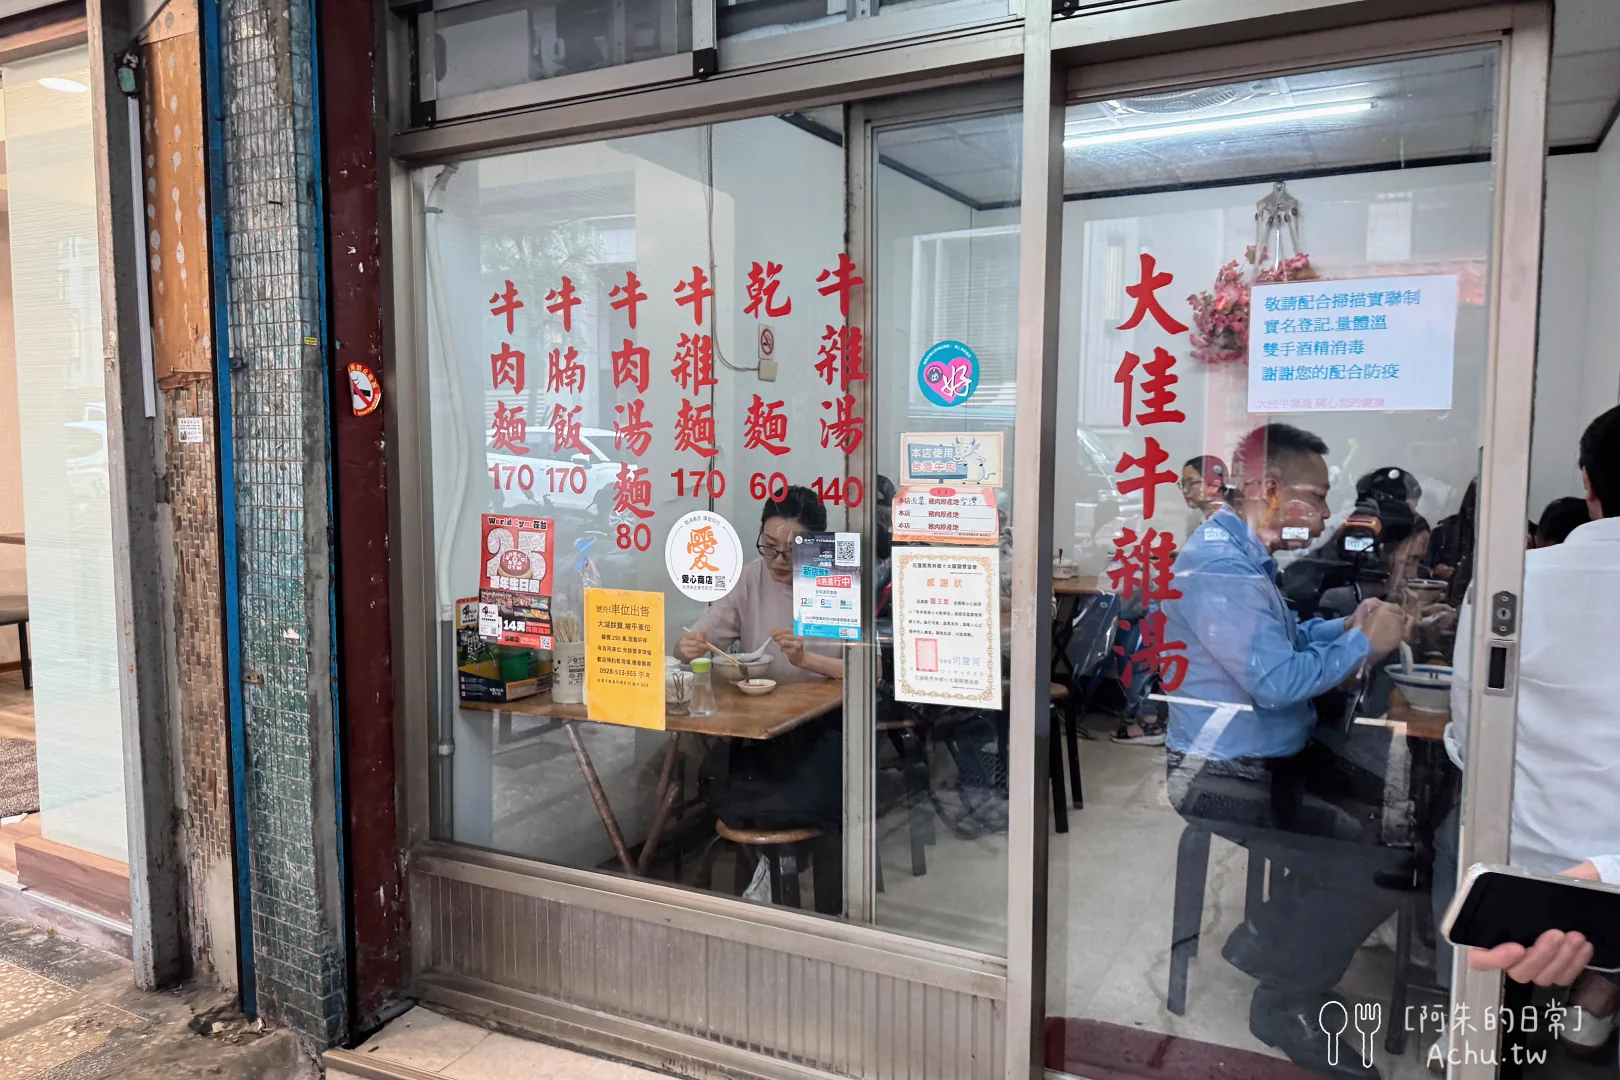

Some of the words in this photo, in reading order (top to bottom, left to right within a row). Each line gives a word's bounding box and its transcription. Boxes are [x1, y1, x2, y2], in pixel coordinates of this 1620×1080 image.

[1263, 288, 1421, 312] 敬請配合掃描實聯制
[670, 266, 720, 458] 牛雜麵
[815, 253, 870, 456] 牛雜湯
[1262, 339, 1366, 358] 雙手酒精消毒
[488, 279, 531, 456] 牛肉麵
[545, 275, 593, 456] 牛腩飯
[1261, 363, 1400, 382] 謝謝您的配合防疫
[608, 270, 656, 519] 牛肉湯麵
[911, 448, 953, 459] 本店使用
[911, 461, 957, 473] 台灣牛肉
[487, 463, 535, 491] 170
[545, 465, 588, 495] 170
[670, 468, 726, 499] 170
[749, 472, 789, 501] 60
[1106, 253, 1190, 692] 大佳牛雜湯
[811, 476, 865, 509] 140
[488, 517, 512, 526] World
[512, 519, 533, 528] Gym
[533, 520, 548, 530] 在台
[928, 510, 960, 518] 豬肉原產地
[928, 523, 959, 531] 豬肉原產地
[616, 523, 652, 552] 80
[681, 574, 713, 585] 愛心商店
[599, 667, 637, 678] 0928-513-555
